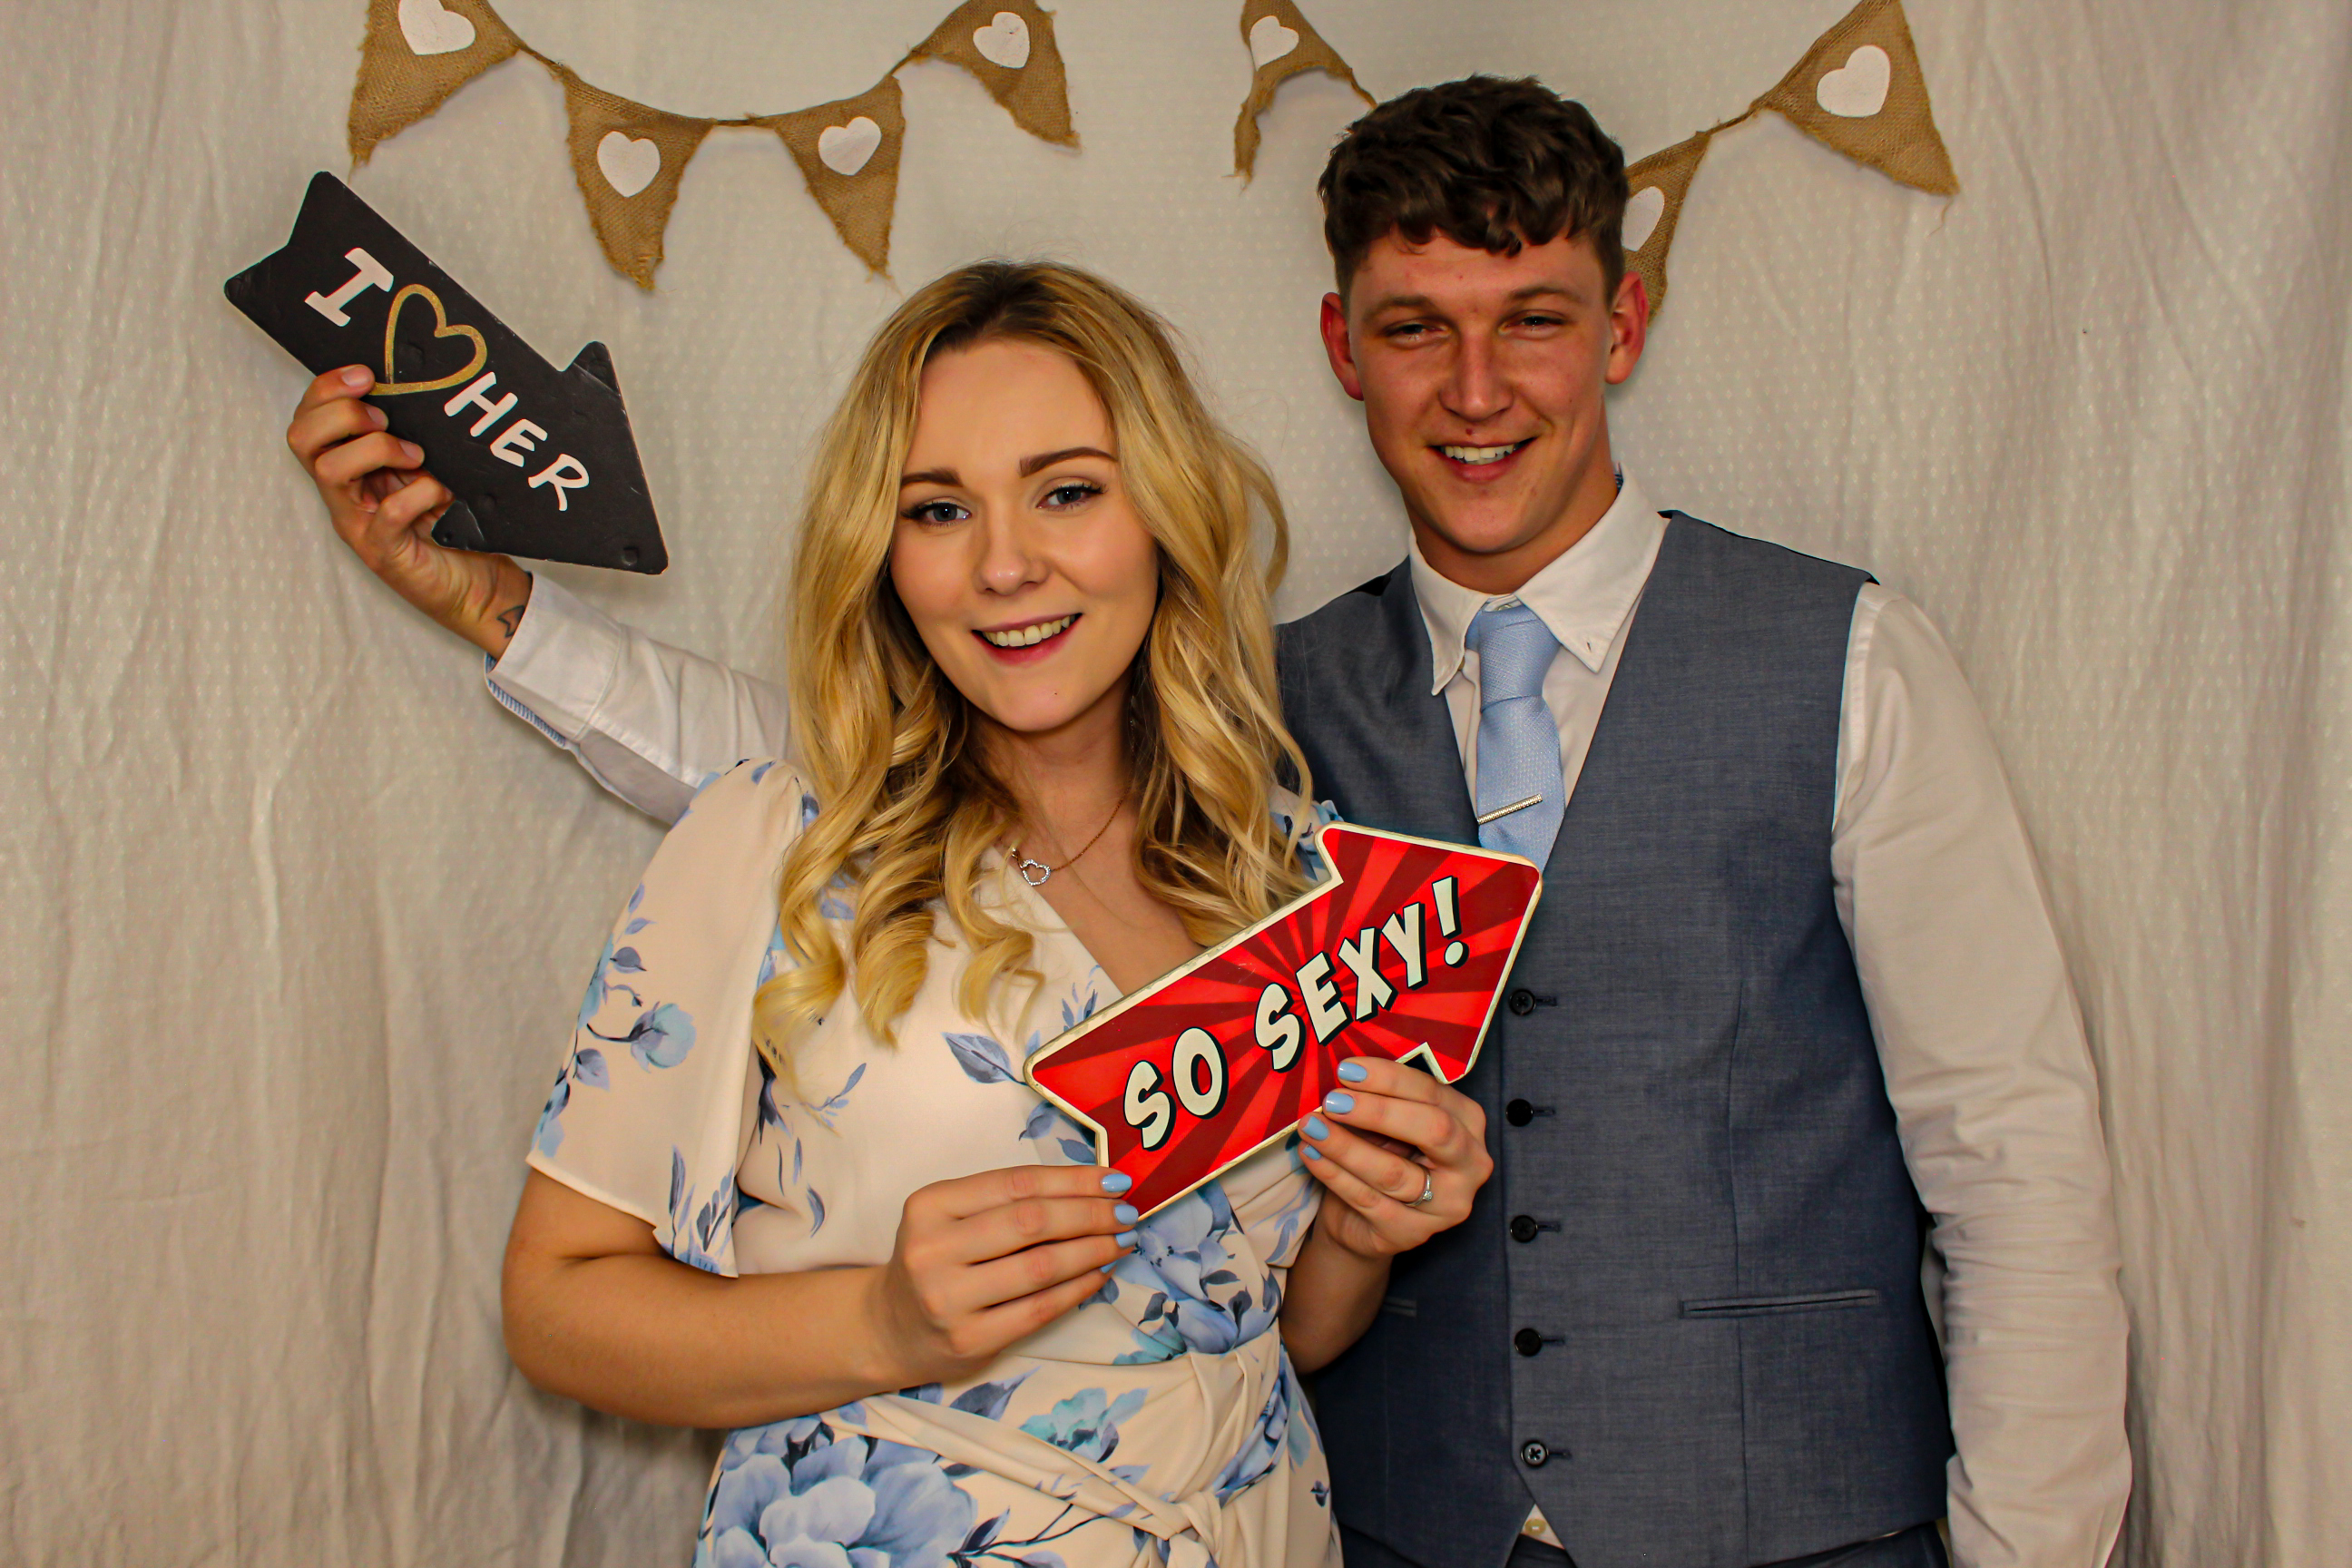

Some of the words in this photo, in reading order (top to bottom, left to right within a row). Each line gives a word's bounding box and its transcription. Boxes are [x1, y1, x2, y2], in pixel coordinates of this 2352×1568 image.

[304, 247, 395, 328] I
[444, 370, 590, 512] HER
[1123, 1026, 1228, 1152] SO
[1254, 875, 1469, 1073] SEXY!
